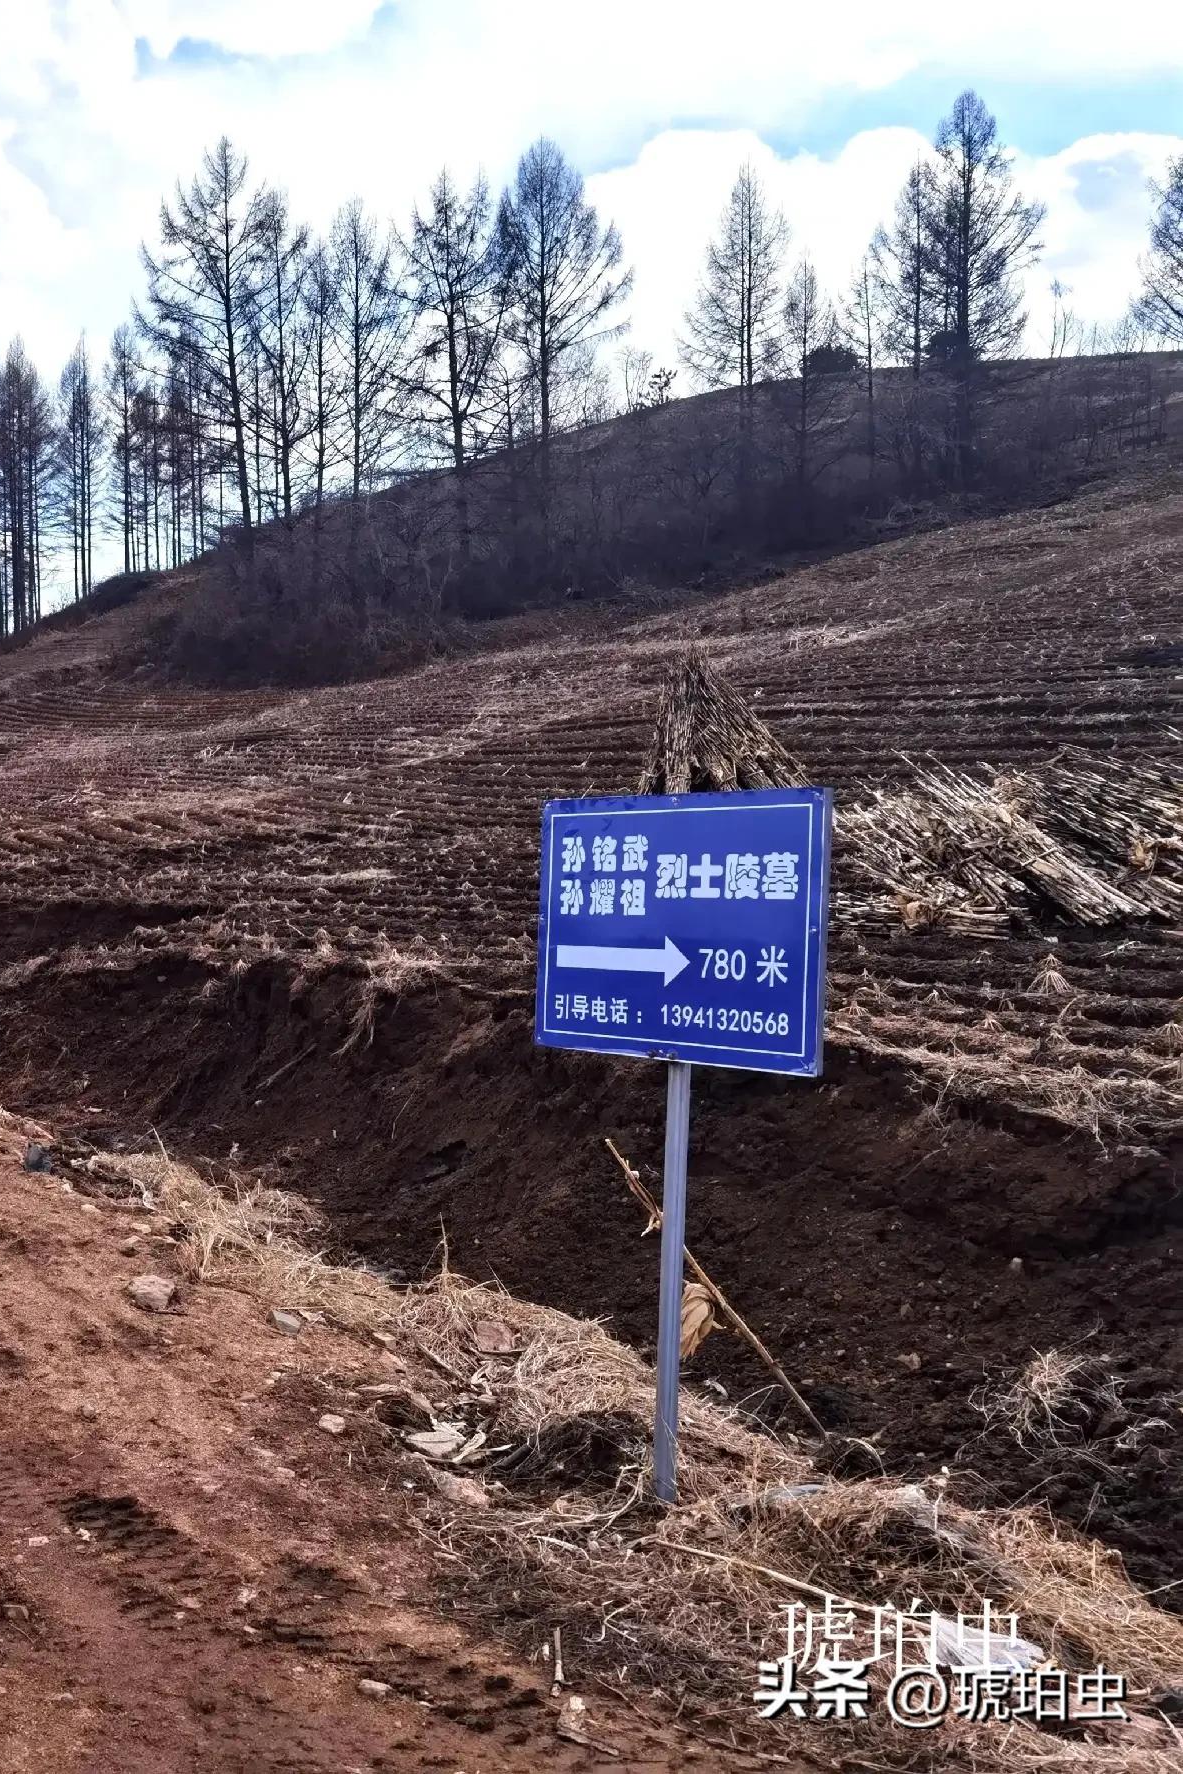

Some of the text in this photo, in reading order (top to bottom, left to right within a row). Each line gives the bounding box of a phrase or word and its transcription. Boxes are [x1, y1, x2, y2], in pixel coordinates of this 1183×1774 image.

[561, 834, 649, 873] 孙铭武
[655, 851, 799, 900] 烈士陵墓
[560, 878, 646, 916] 孙耀祖
[699, 945, 789, 988] 780 米
[660, 1004, 790, 1036] 13941320568
